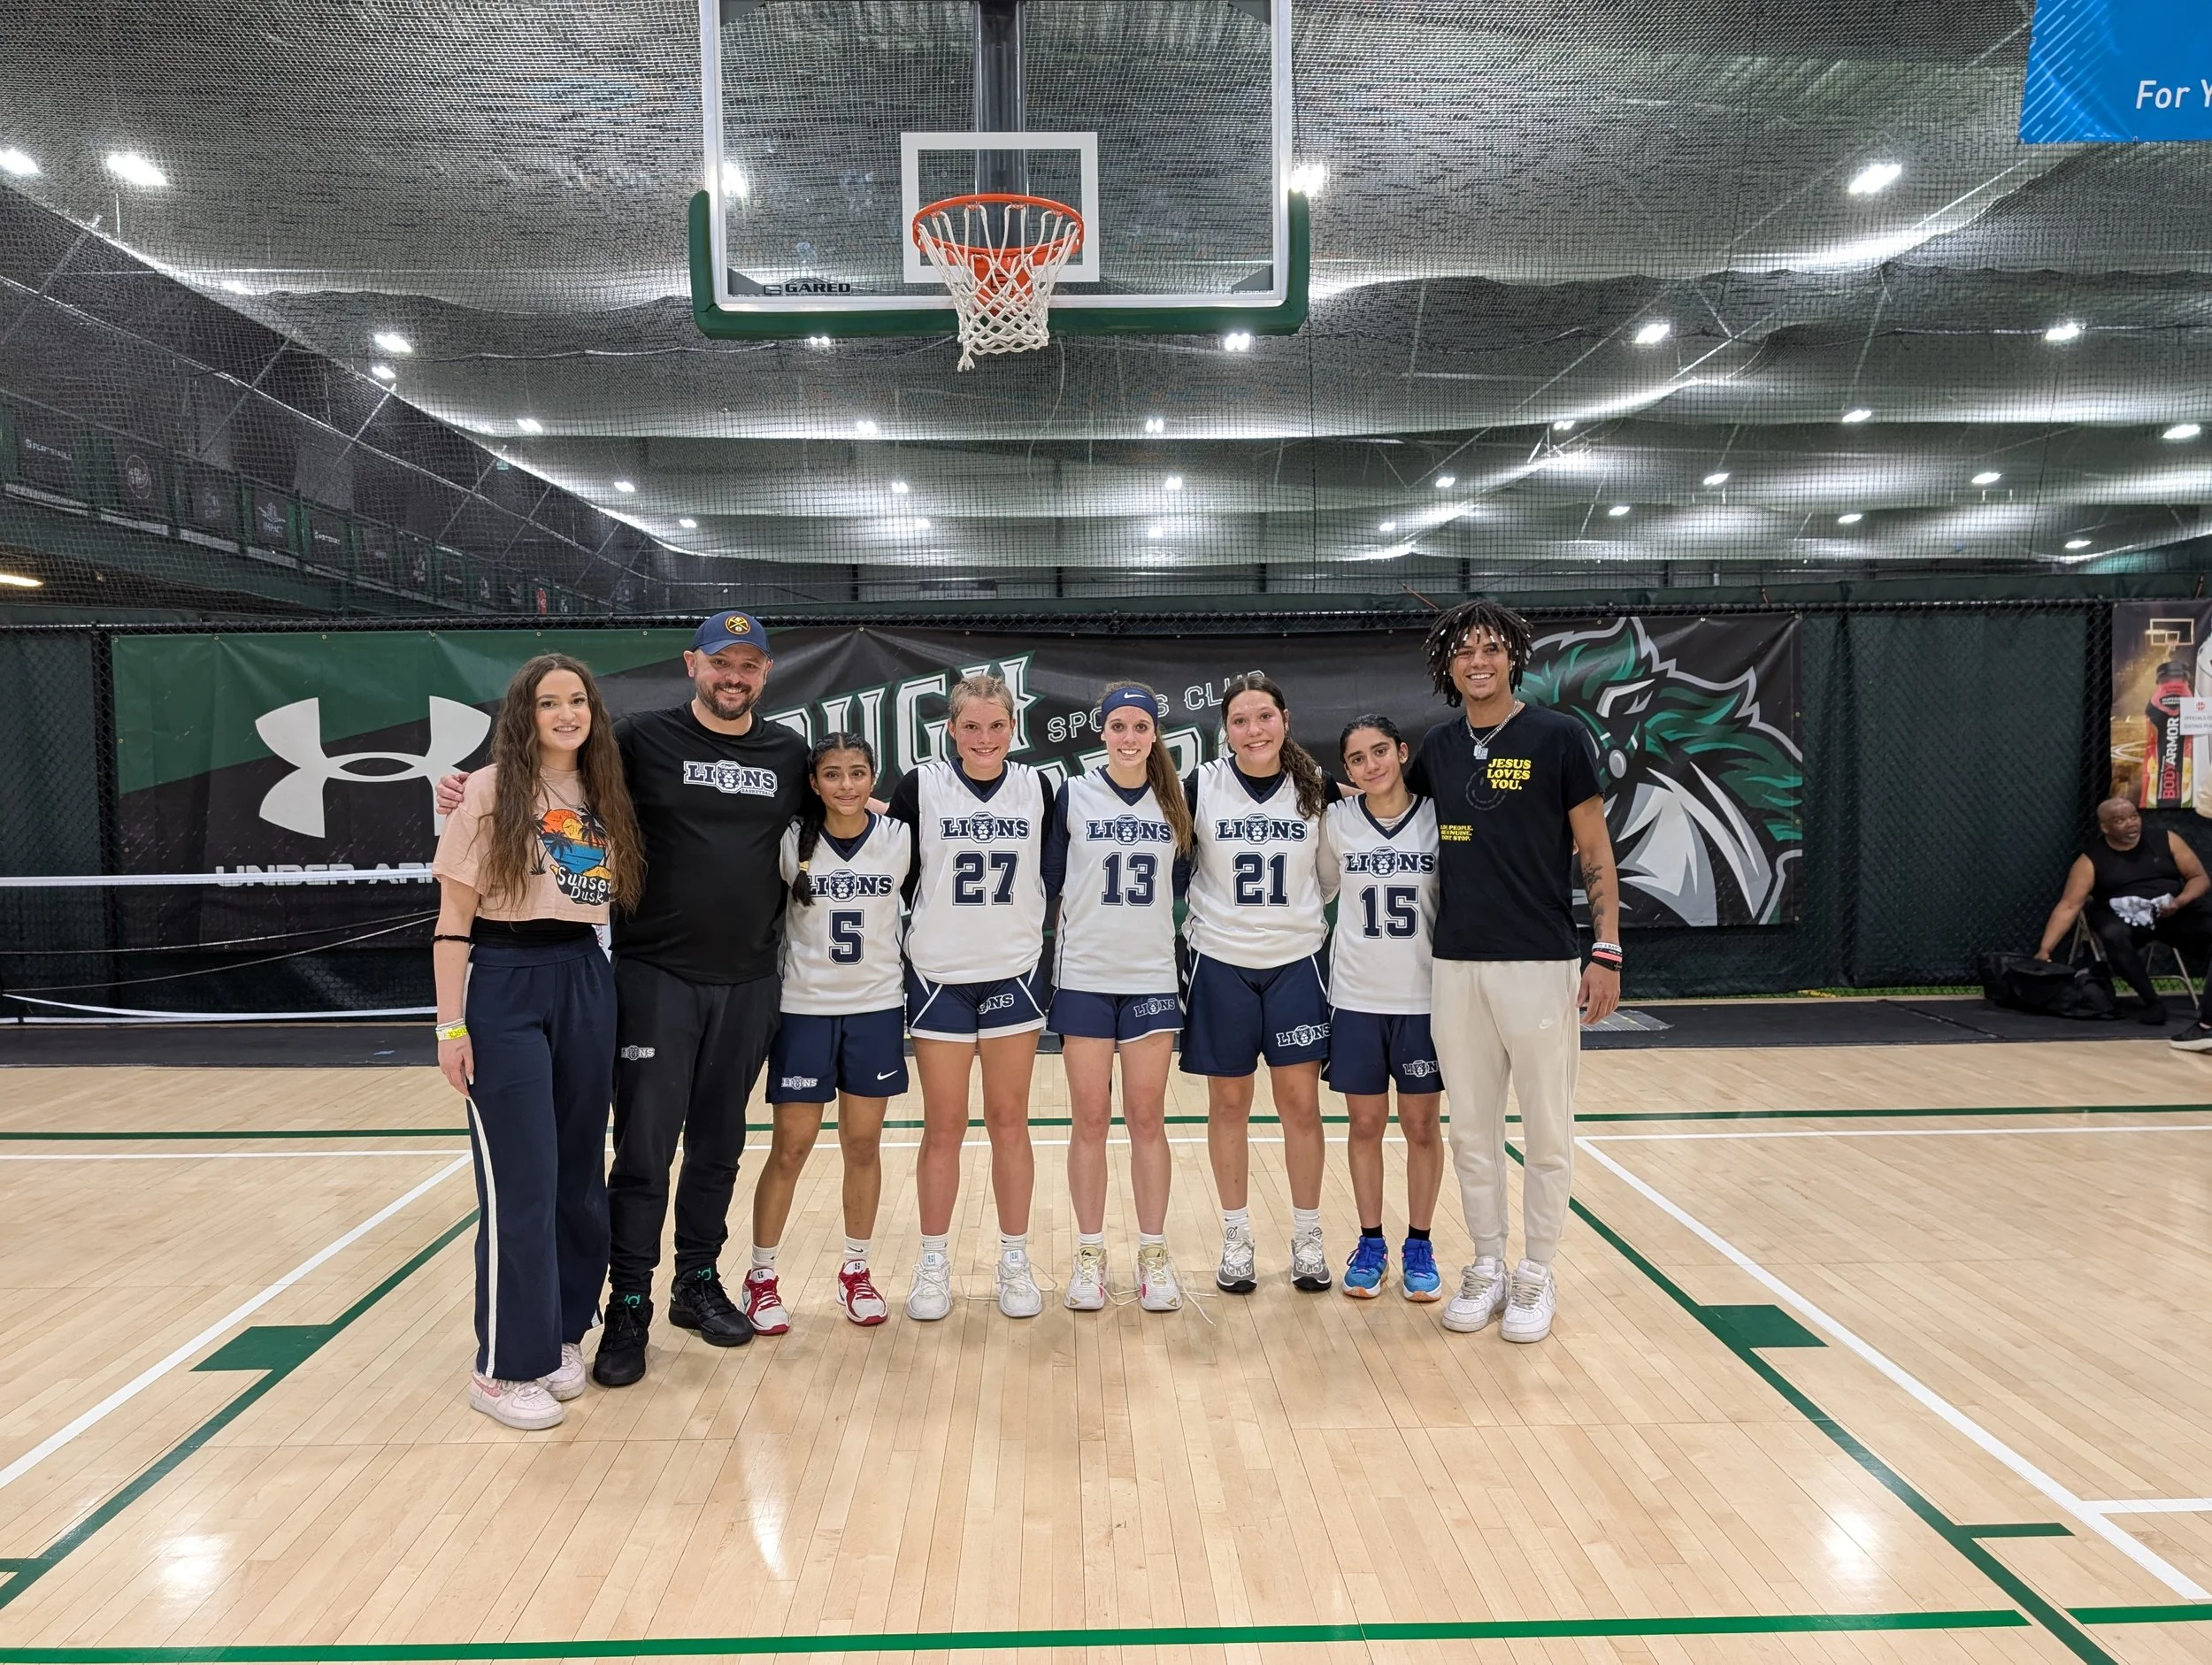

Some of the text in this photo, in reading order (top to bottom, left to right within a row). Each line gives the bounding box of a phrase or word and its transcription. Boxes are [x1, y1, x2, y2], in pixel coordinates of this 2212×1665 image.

[2135, 80, 2191, 110] For
[785, 283, 851, 293] GARED
[1486, 769, 1531, 780] LOVES
[1488, 758, 1532, 770] JESUS
[1491, 779, 1522, 790] YOU.
[940, 811, 1030, 843] LIONS
[1087, 814, 1172, 845] LIONS
[1216, 813, 1308, 845] LIONS
[952, 850, 1019, 906] 27
[1343, 846, 1435, 878] LIONS
[570, 886, 604, 904] Dusk
[1101, 852, 1158, 906] 13
[1233, 852, 1289, 907] 21
[1359, 885, 1418, 939] 15
[829, 909, 864, 965] 5
